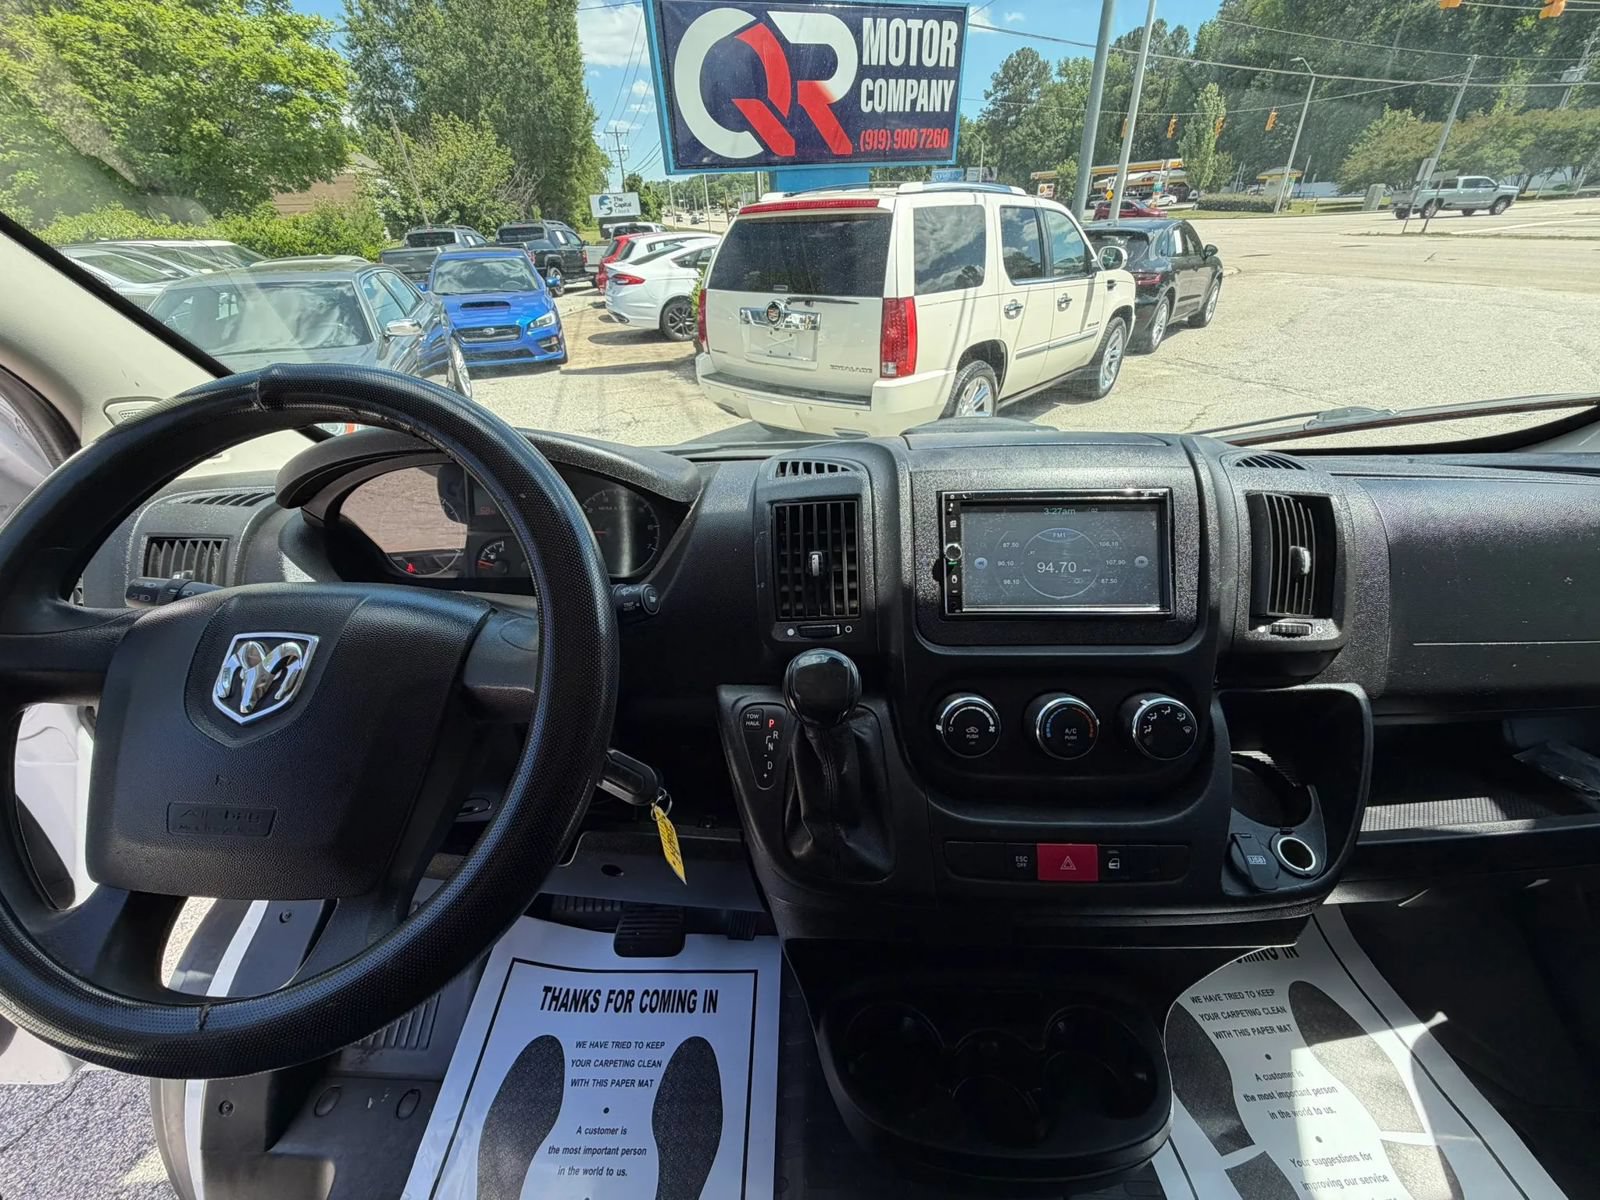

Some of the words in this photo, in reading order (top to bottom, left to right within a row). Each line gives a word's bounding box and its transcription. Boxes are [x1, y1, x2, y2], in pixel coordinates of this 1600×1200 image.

[862, 18, 958, 67] MOTOR
[674, 7, 858, 158] QR
[860, 78, 956, 112] COMPANY
[860, 128, 891, 152] (919)
[894, 128, 918, 149] 900
[920, 128, 949, 148] 7260
[1036, 562, 1077, 573] 94.70
[768, 719, 775, 728] P
[772, 731, 779, 739] R
[768, 742, 773, 751] N
[767, 761, 773, 770] D
[540, 986, 601, 1013] THANKS
[604, 989, 634, 1013] FOR
[639, 989, 697, 1013] COMING
[702, 989, 718, 1014] IN
[1190, 996, 1202, 1004] WE
[1203, 994, 1223, 1002] HAVE
[1224, 992, 1245, 1001] TRIED
[1245, 990, 1256, 999] TO
[1256, 988, 1275, 997] KEEP
[1199, 1012, 1220, 1022] YOUR
[1221, 1009, 1262, 1019] CARPETING
[1262, 1006, 1287, 1015] CLEAN
[1213, 1030, 1233, 1040] WITH
[1233, 1028, 1251, 1037] THIS
[1251, 1025, 1276, 1036] PAPER
[1276, 1024, 1293, 1033] MAT
[575, 1041, 587, 1049] WE
[589, 1041, 609, 1049] HAVE
[611, 1041, 632, 1049] TRIED
[634, 1041, 644, 1049] TO
[646, 1041, 665, 1049] KEEP
[571, 1059, 591, 1068] YOUR
[594, 1059, 635, 1068] CARPETING
[638, 1059, 662, 1068] CLEAN
[1254, 1073, 1263, 1082] A
[1263, 1071, 1294, 1081] customer
[570, 1079, 589, 1087] WITH
[592, 1079, 608, 1087] THIS
[610, 1079, 635, 1087] PAPER
[638, 1079, 654, 1087] MAT
[1243, 1093, 1256, 1102] the
[1257, 1091, 1277, 1101] most
[1276, 1088, 1312, 1100] important
[1312, 1086, 1338, 1096] person
[1267, 1110, 1278, 1120] in
[1277, 1109, 1291, 1119] the
[1291, 1106, 1313, 1117] world
[1313, 1106, 1323, 1115] to
[1323, 1106, 1336, 1115] us.
[576, 1126, 582, 1135] A
[585, 1127, 618, 1135] customer
[620, 1126, 627, 1135] is
[548, 1146, 560, 1155] the
[562, 1146, 581, 1155] most
[583, 1146, 619, 1157] important
[621, 1148, 647, 1157] person
[1289, 1158, 1310, 1168] Your
[1311, 1153, 1360, 1167] suggestions
[1359, 1152, 1373, 1161] for
[558, 1166, 565, 1175] in
[568, 1166, 580, 1175] the
[582, 1166, 604, 1176] world
[606, 1167, 614, 1176] to
[616, 1168, 627, 1176] us.
[1300, 1178, 1344, 1192] improving
[1344, 1177, 1358, 1186] our
[1359, 1173, 1390, 1185] service
